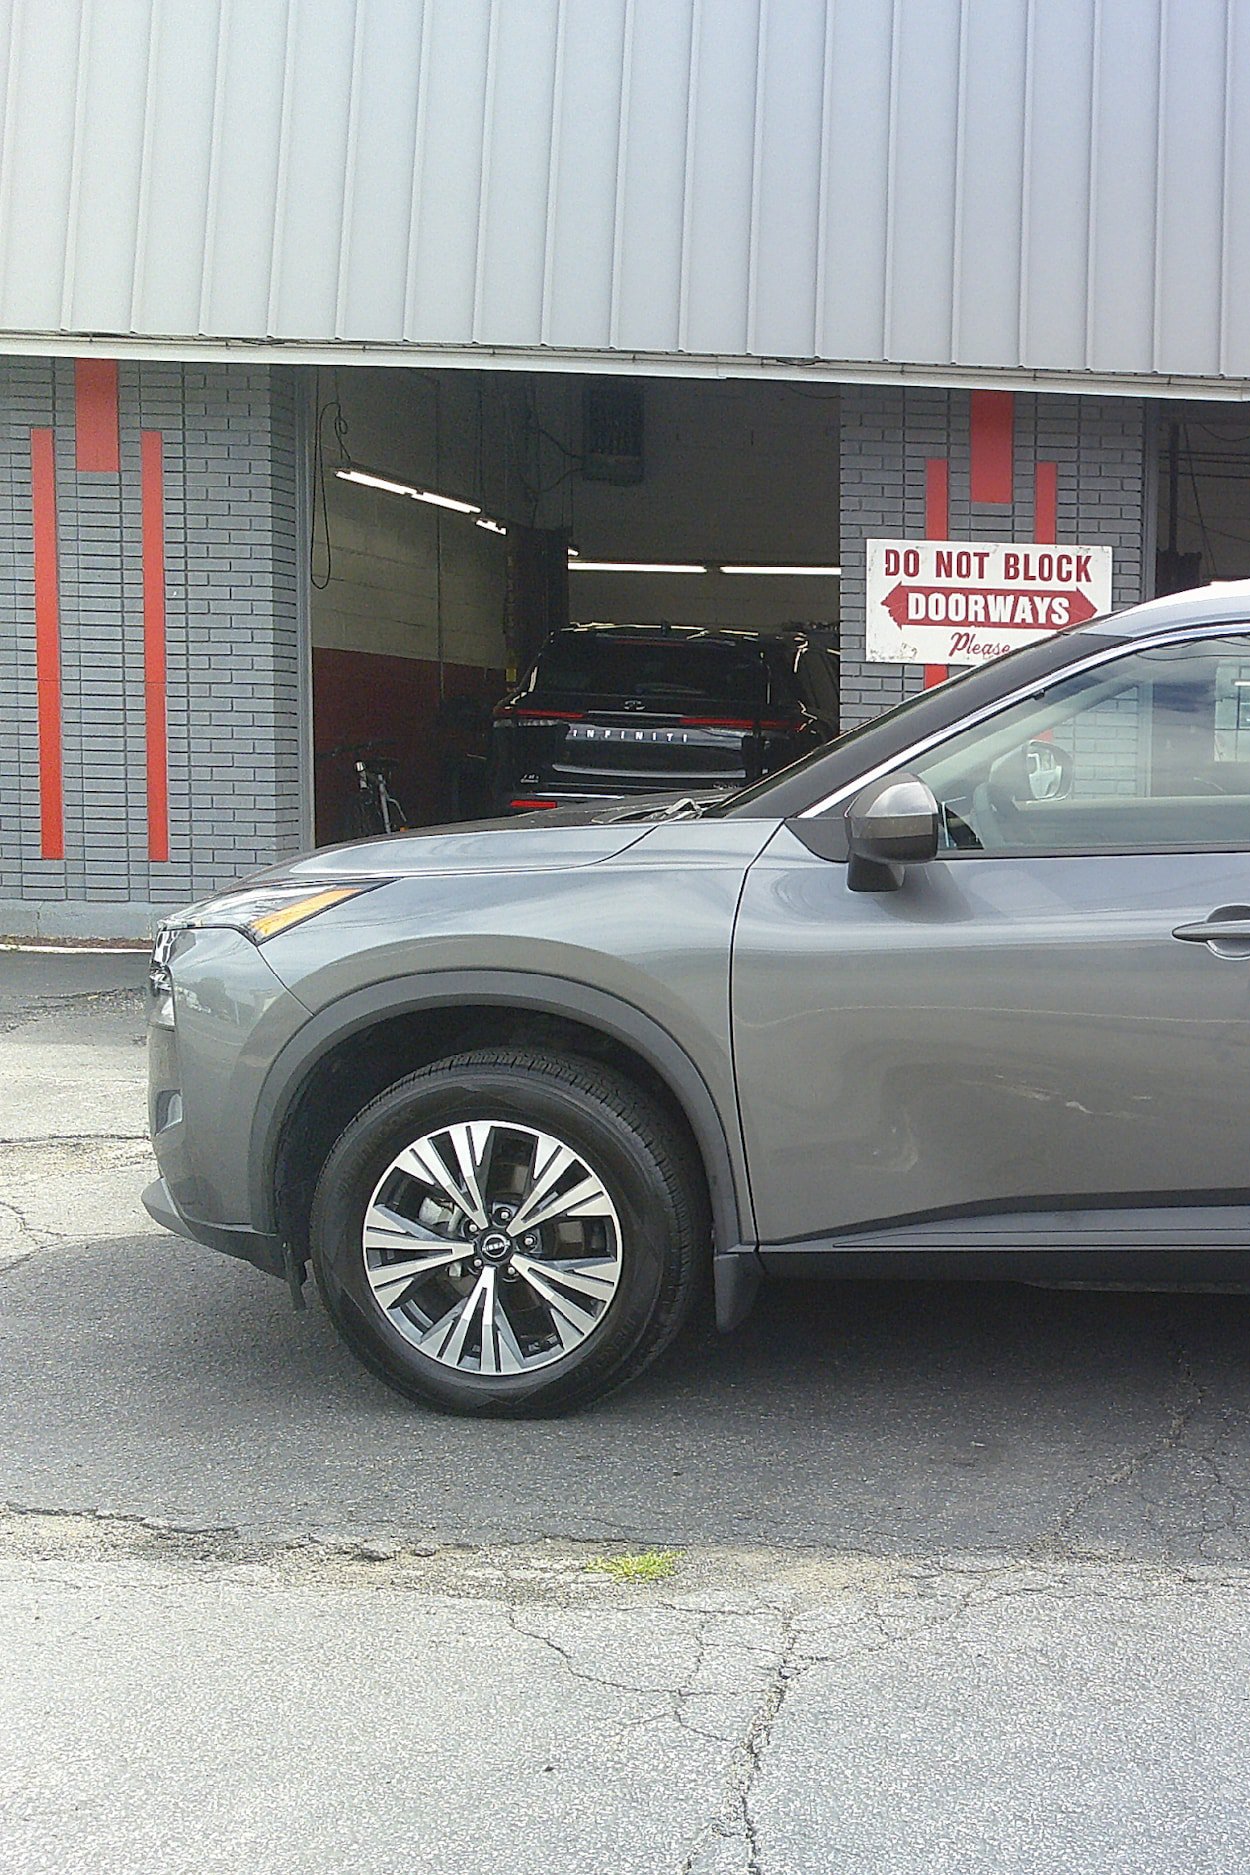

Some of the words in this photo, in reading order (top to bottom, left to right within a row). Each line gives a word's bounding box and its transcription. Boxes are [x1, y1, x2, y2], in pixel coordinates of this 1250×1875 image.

[884, 549, 920, 577] DO
[935, 550, 990, 579] NOT
[1004, 553, 1093, 583] BLOCK
[907, 592, 1070, 626] DOORWAYS
[948, 631, 1011, 657] Please
[572, 729, 689, 743] INFINITI
